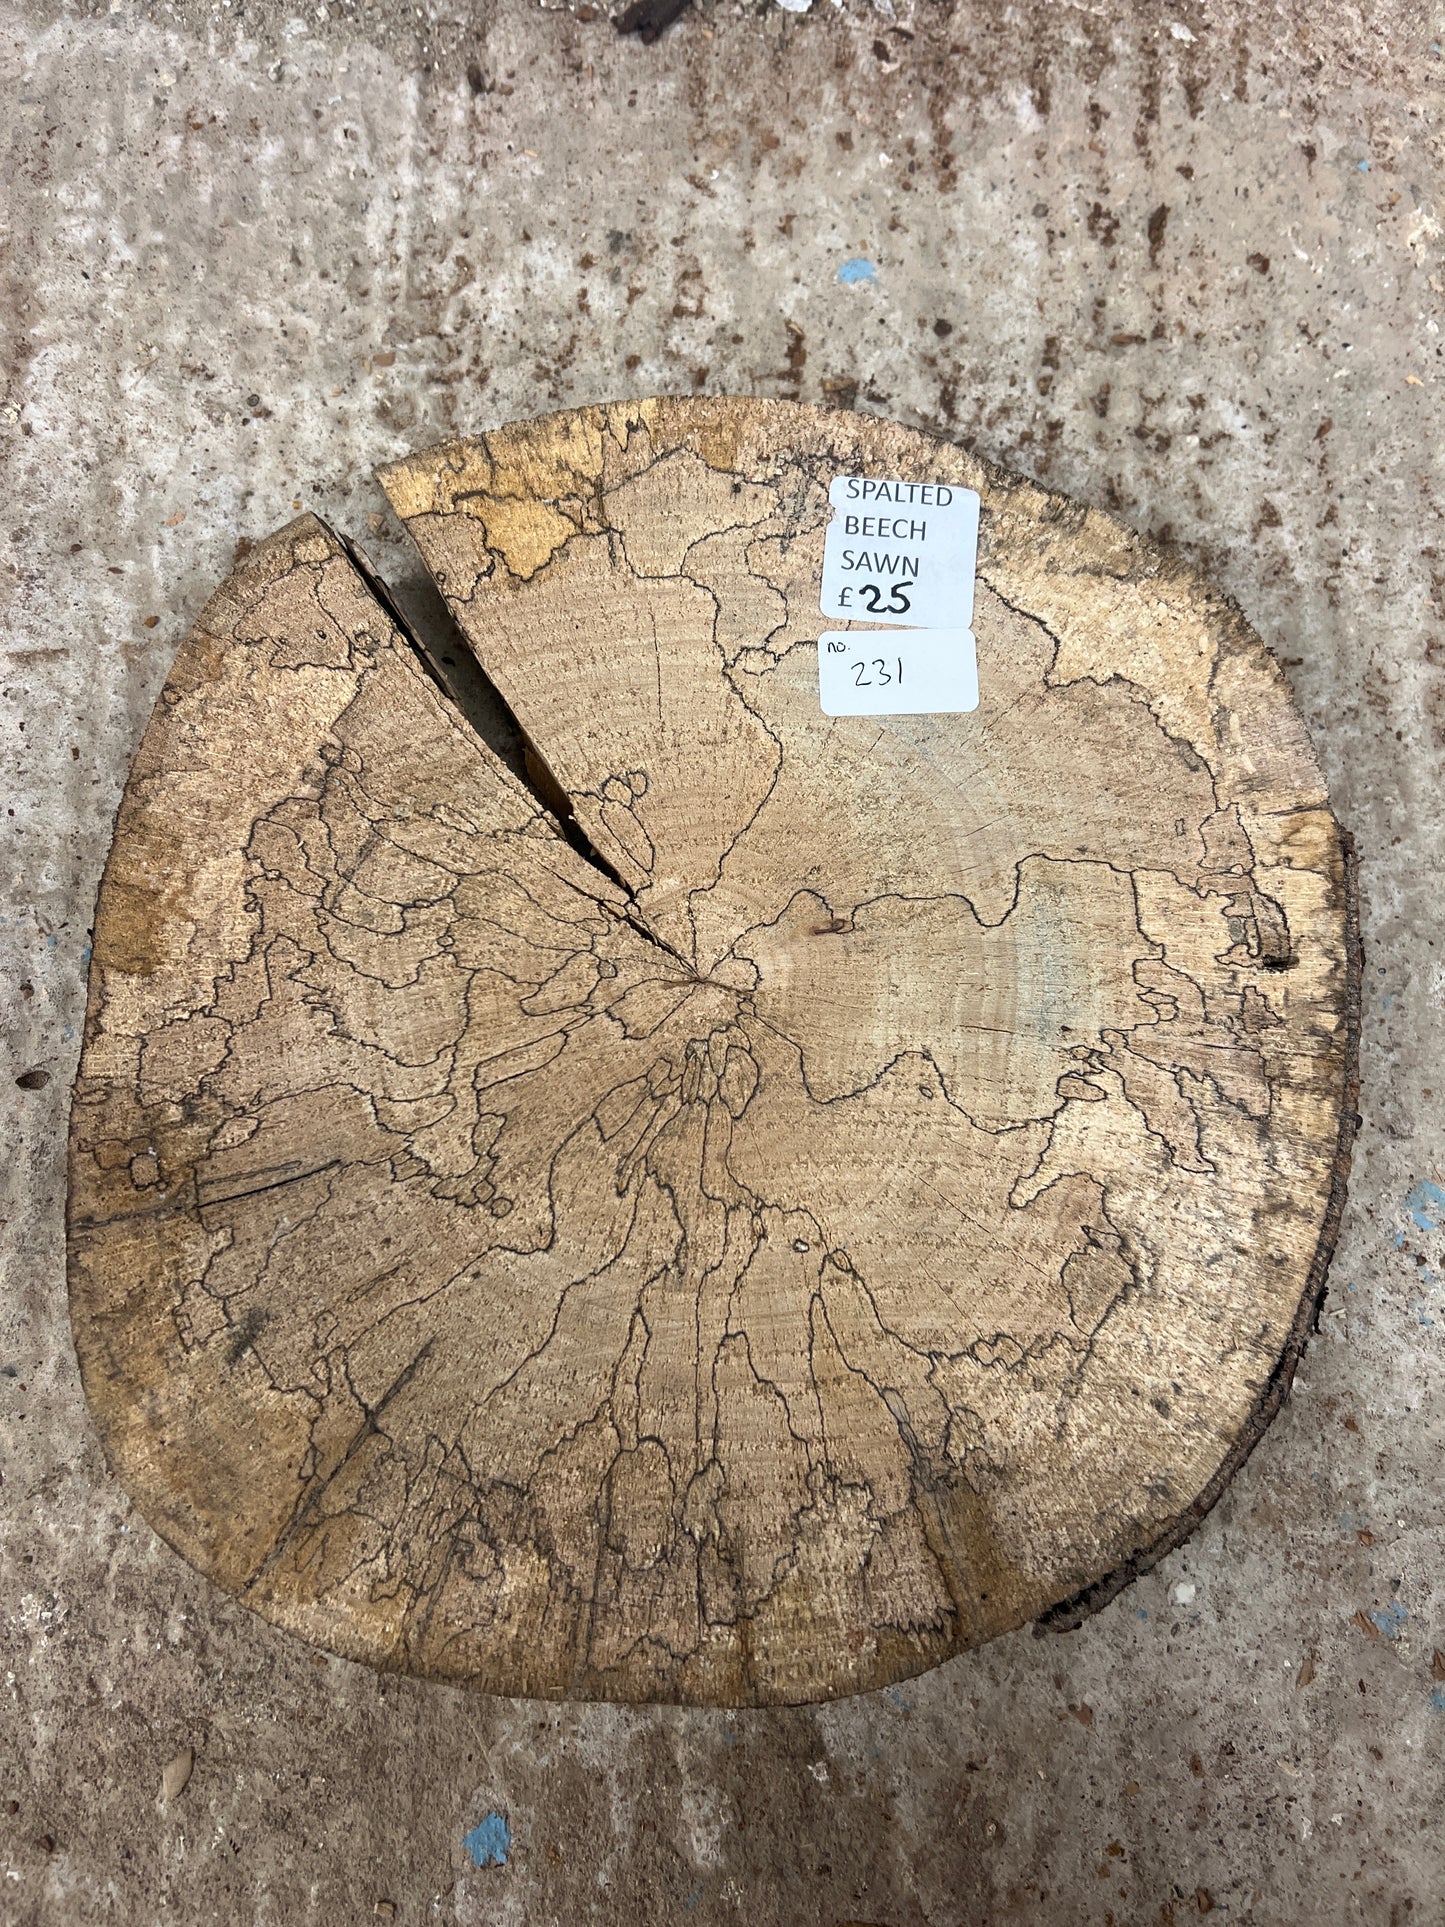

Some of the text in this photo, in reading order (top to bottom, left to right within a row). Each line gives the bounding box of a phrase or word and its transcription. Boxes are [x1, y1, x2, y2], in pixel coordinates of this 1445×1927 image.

[846, 478, 953, 507] SPALTED
[845, 515, 926, 541] BEECH
[840, 550, 919, 578] SAWN
[838, 581, 913, 614] £25
[850, 657, 903, 686] 231
